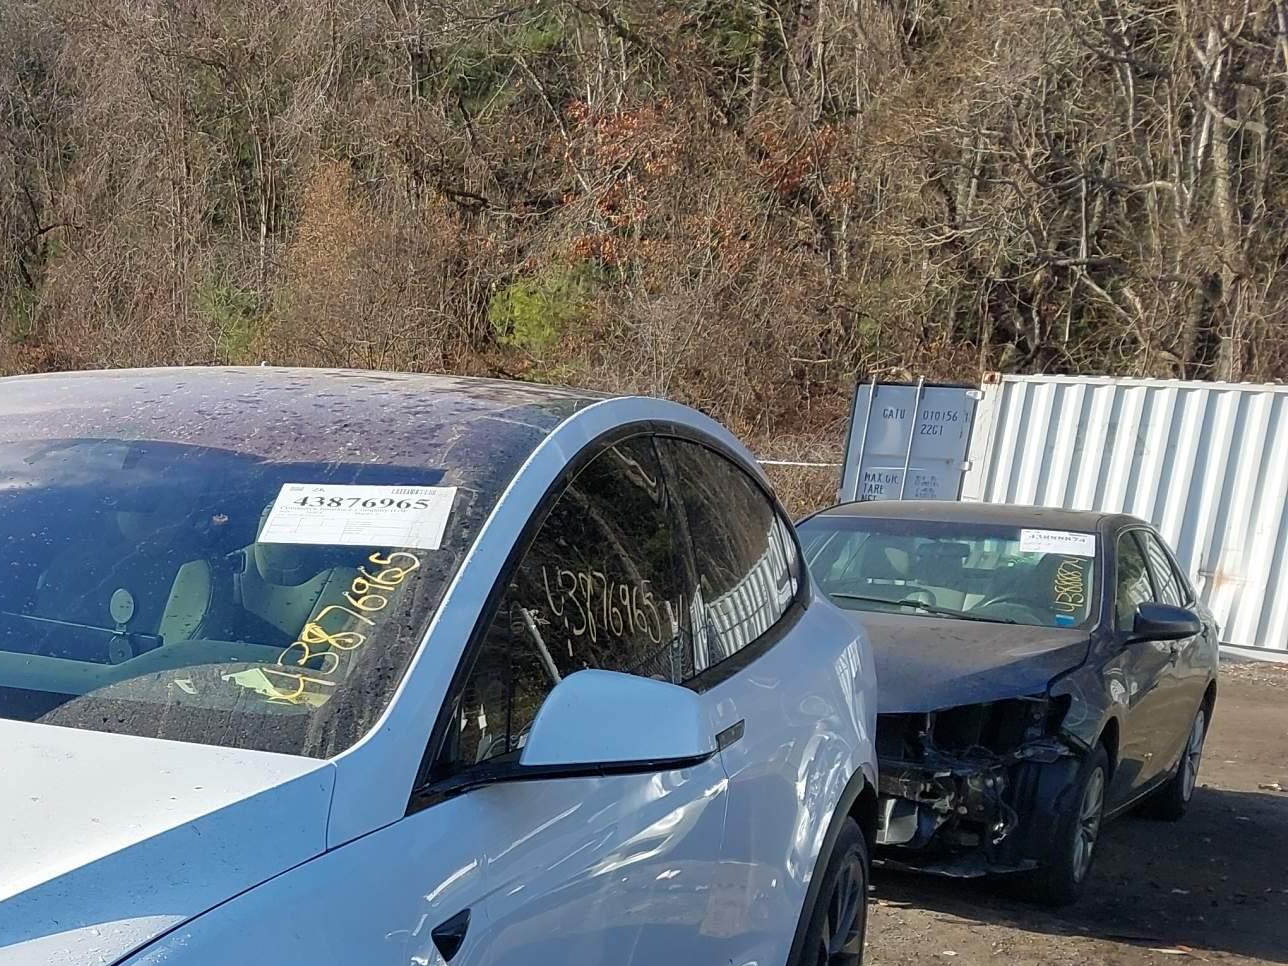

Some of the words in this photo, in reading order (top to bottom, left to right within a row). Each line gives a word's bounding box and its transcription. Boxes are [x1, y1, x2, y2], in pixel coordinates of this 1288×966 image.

[922, 410, 958, 421] 010156
[293, 495, 431, 510] 43876965
[263, 551, 421, 703] 43876965
[542, 565, 662, 657] 43876965
